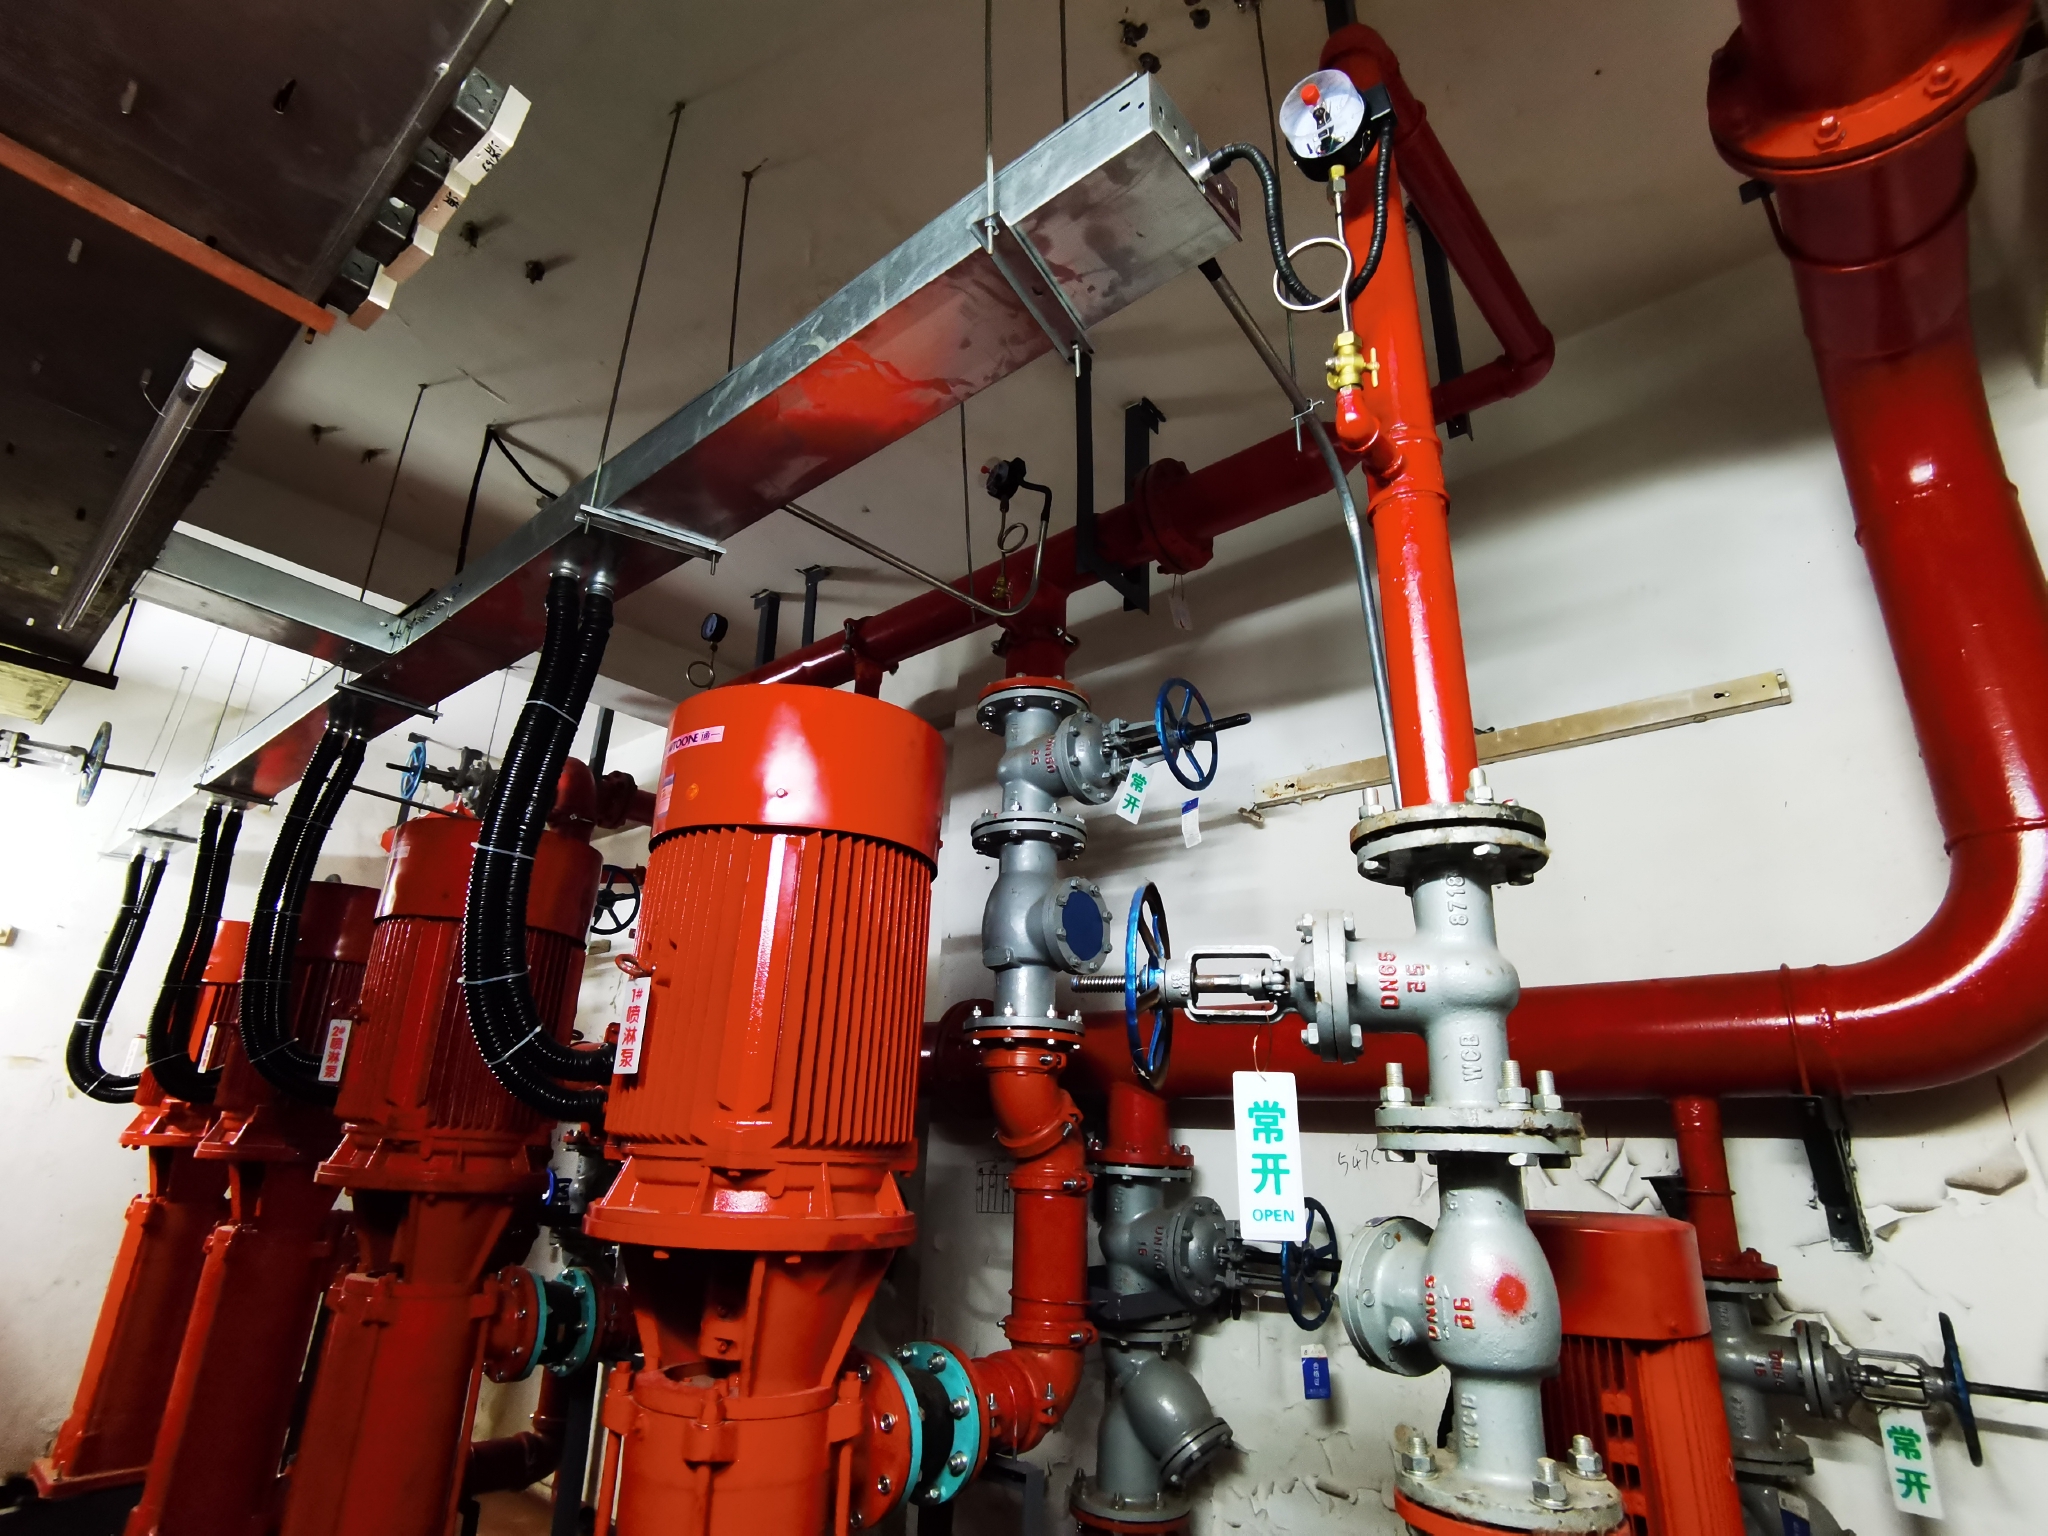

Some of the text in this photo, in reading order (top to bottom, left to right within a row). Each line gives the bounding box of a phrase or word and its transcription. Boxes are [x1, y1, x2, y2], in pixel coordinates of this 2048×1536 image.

[1122, 772, 1148, 814] 常开
[1378, 951, 1400, 1009] DN65
[1406, 963, 1427, 993] 25
[1460, 1033, 1483, 1081] WCB
[1248, 1100, 1290, 1195] 常开
[1252, 1208, 1295, 1222] OPEN
[1886, 1425, 1931, 1504] 常开
